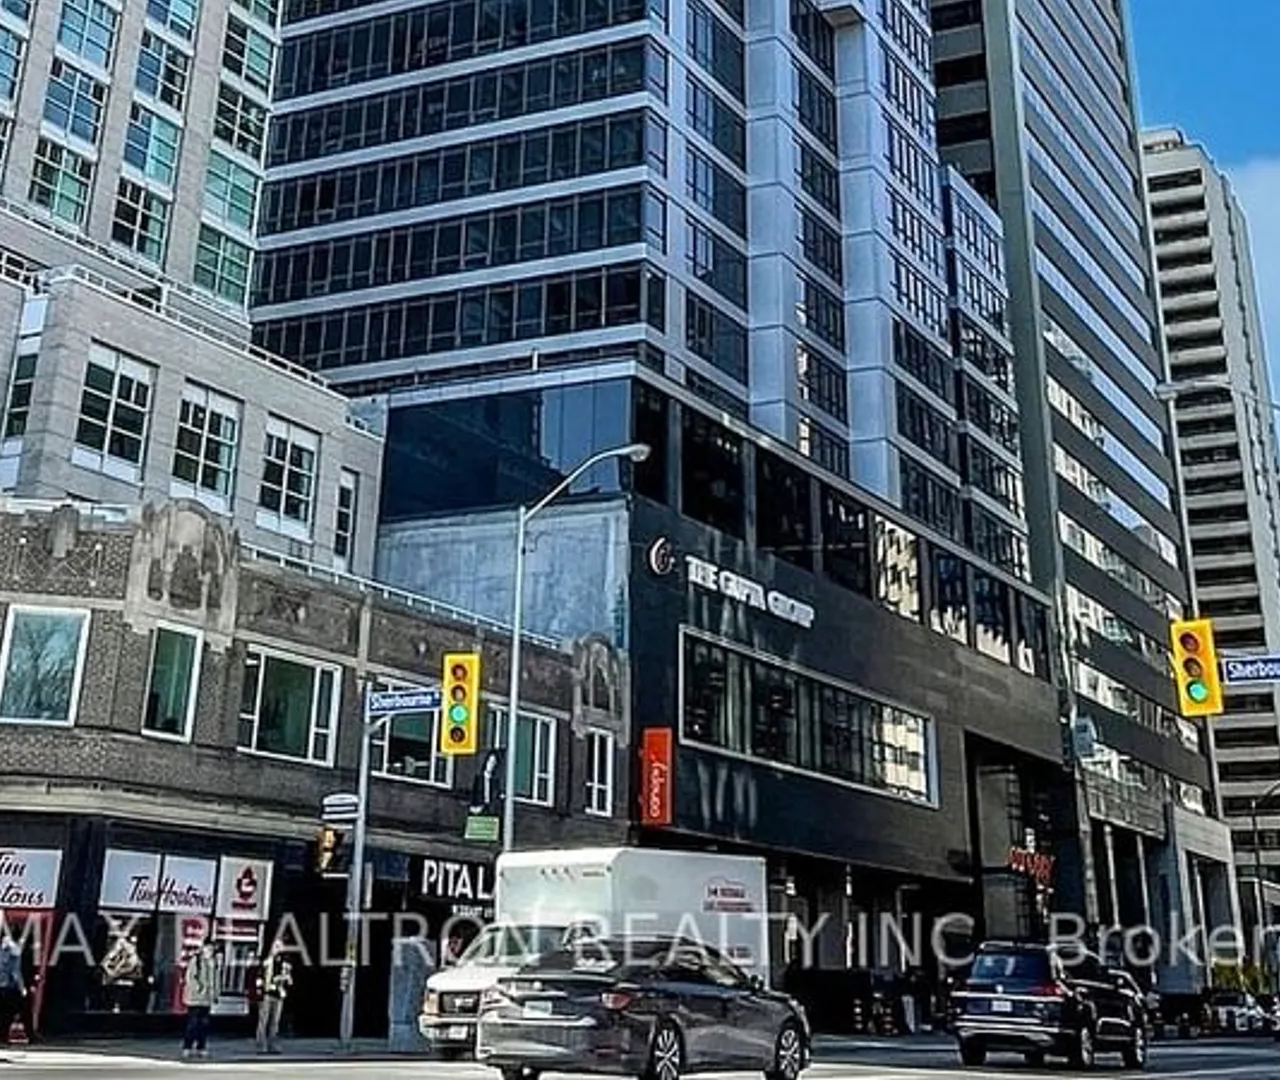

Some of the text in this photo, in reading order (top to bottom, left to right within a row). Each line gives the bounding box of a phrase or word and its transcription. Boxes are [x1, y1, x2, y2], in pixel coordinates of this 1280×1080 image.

[129, 875, 212, 909] Tim Hortons
[422, 859, 473, 898] PITA
